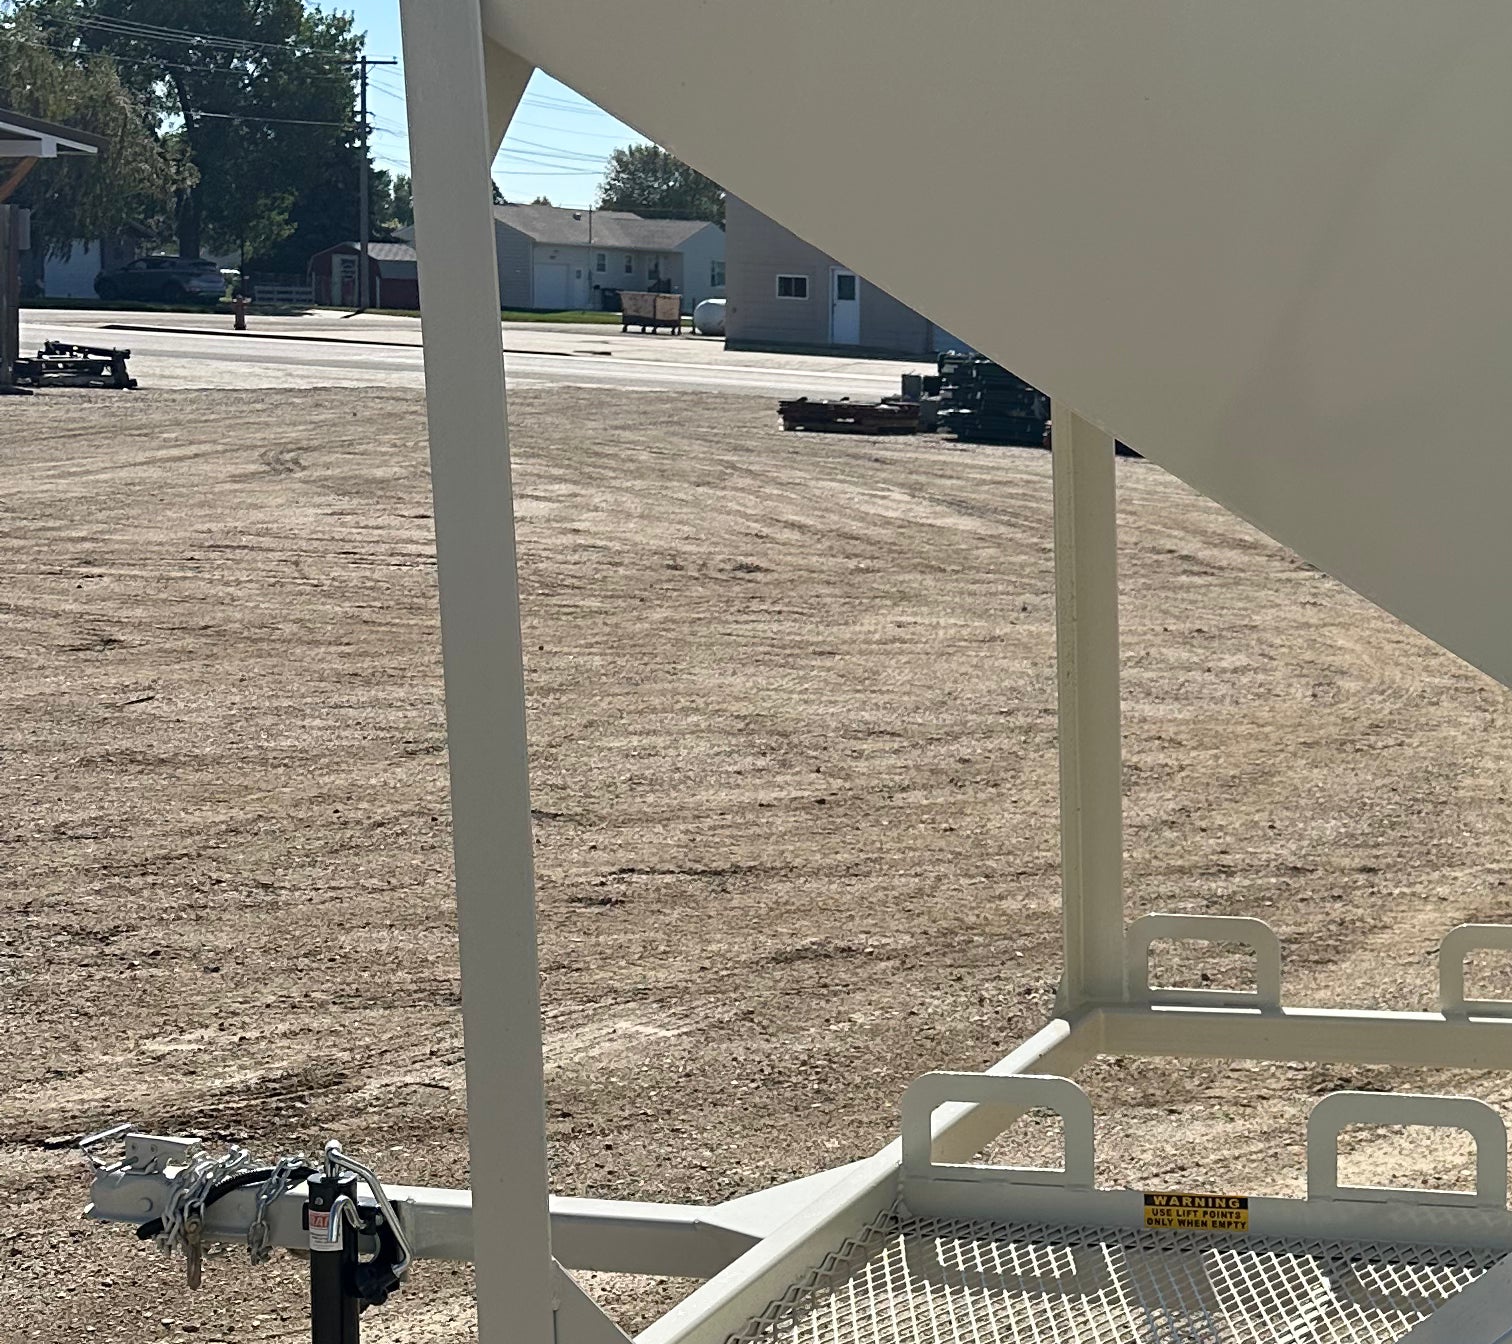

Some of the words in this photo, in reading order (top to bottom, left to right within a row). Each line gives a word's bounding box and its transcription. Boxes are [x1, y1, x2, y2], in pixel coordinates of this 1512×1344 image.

[1153, 1195, 1240, 1208] WARNING
[1152, 1208, 1173, 1217] USE
[1176, 1209, 1199, 1218] LIFT
[1202, 1210, 1242, 1220] POINTS
[1146, 1217, 1174, 1226] ONLY
[1177, 1218, 1208, 1228] WHEN
[1211, 1220, 1247, 1229] EMPTY
